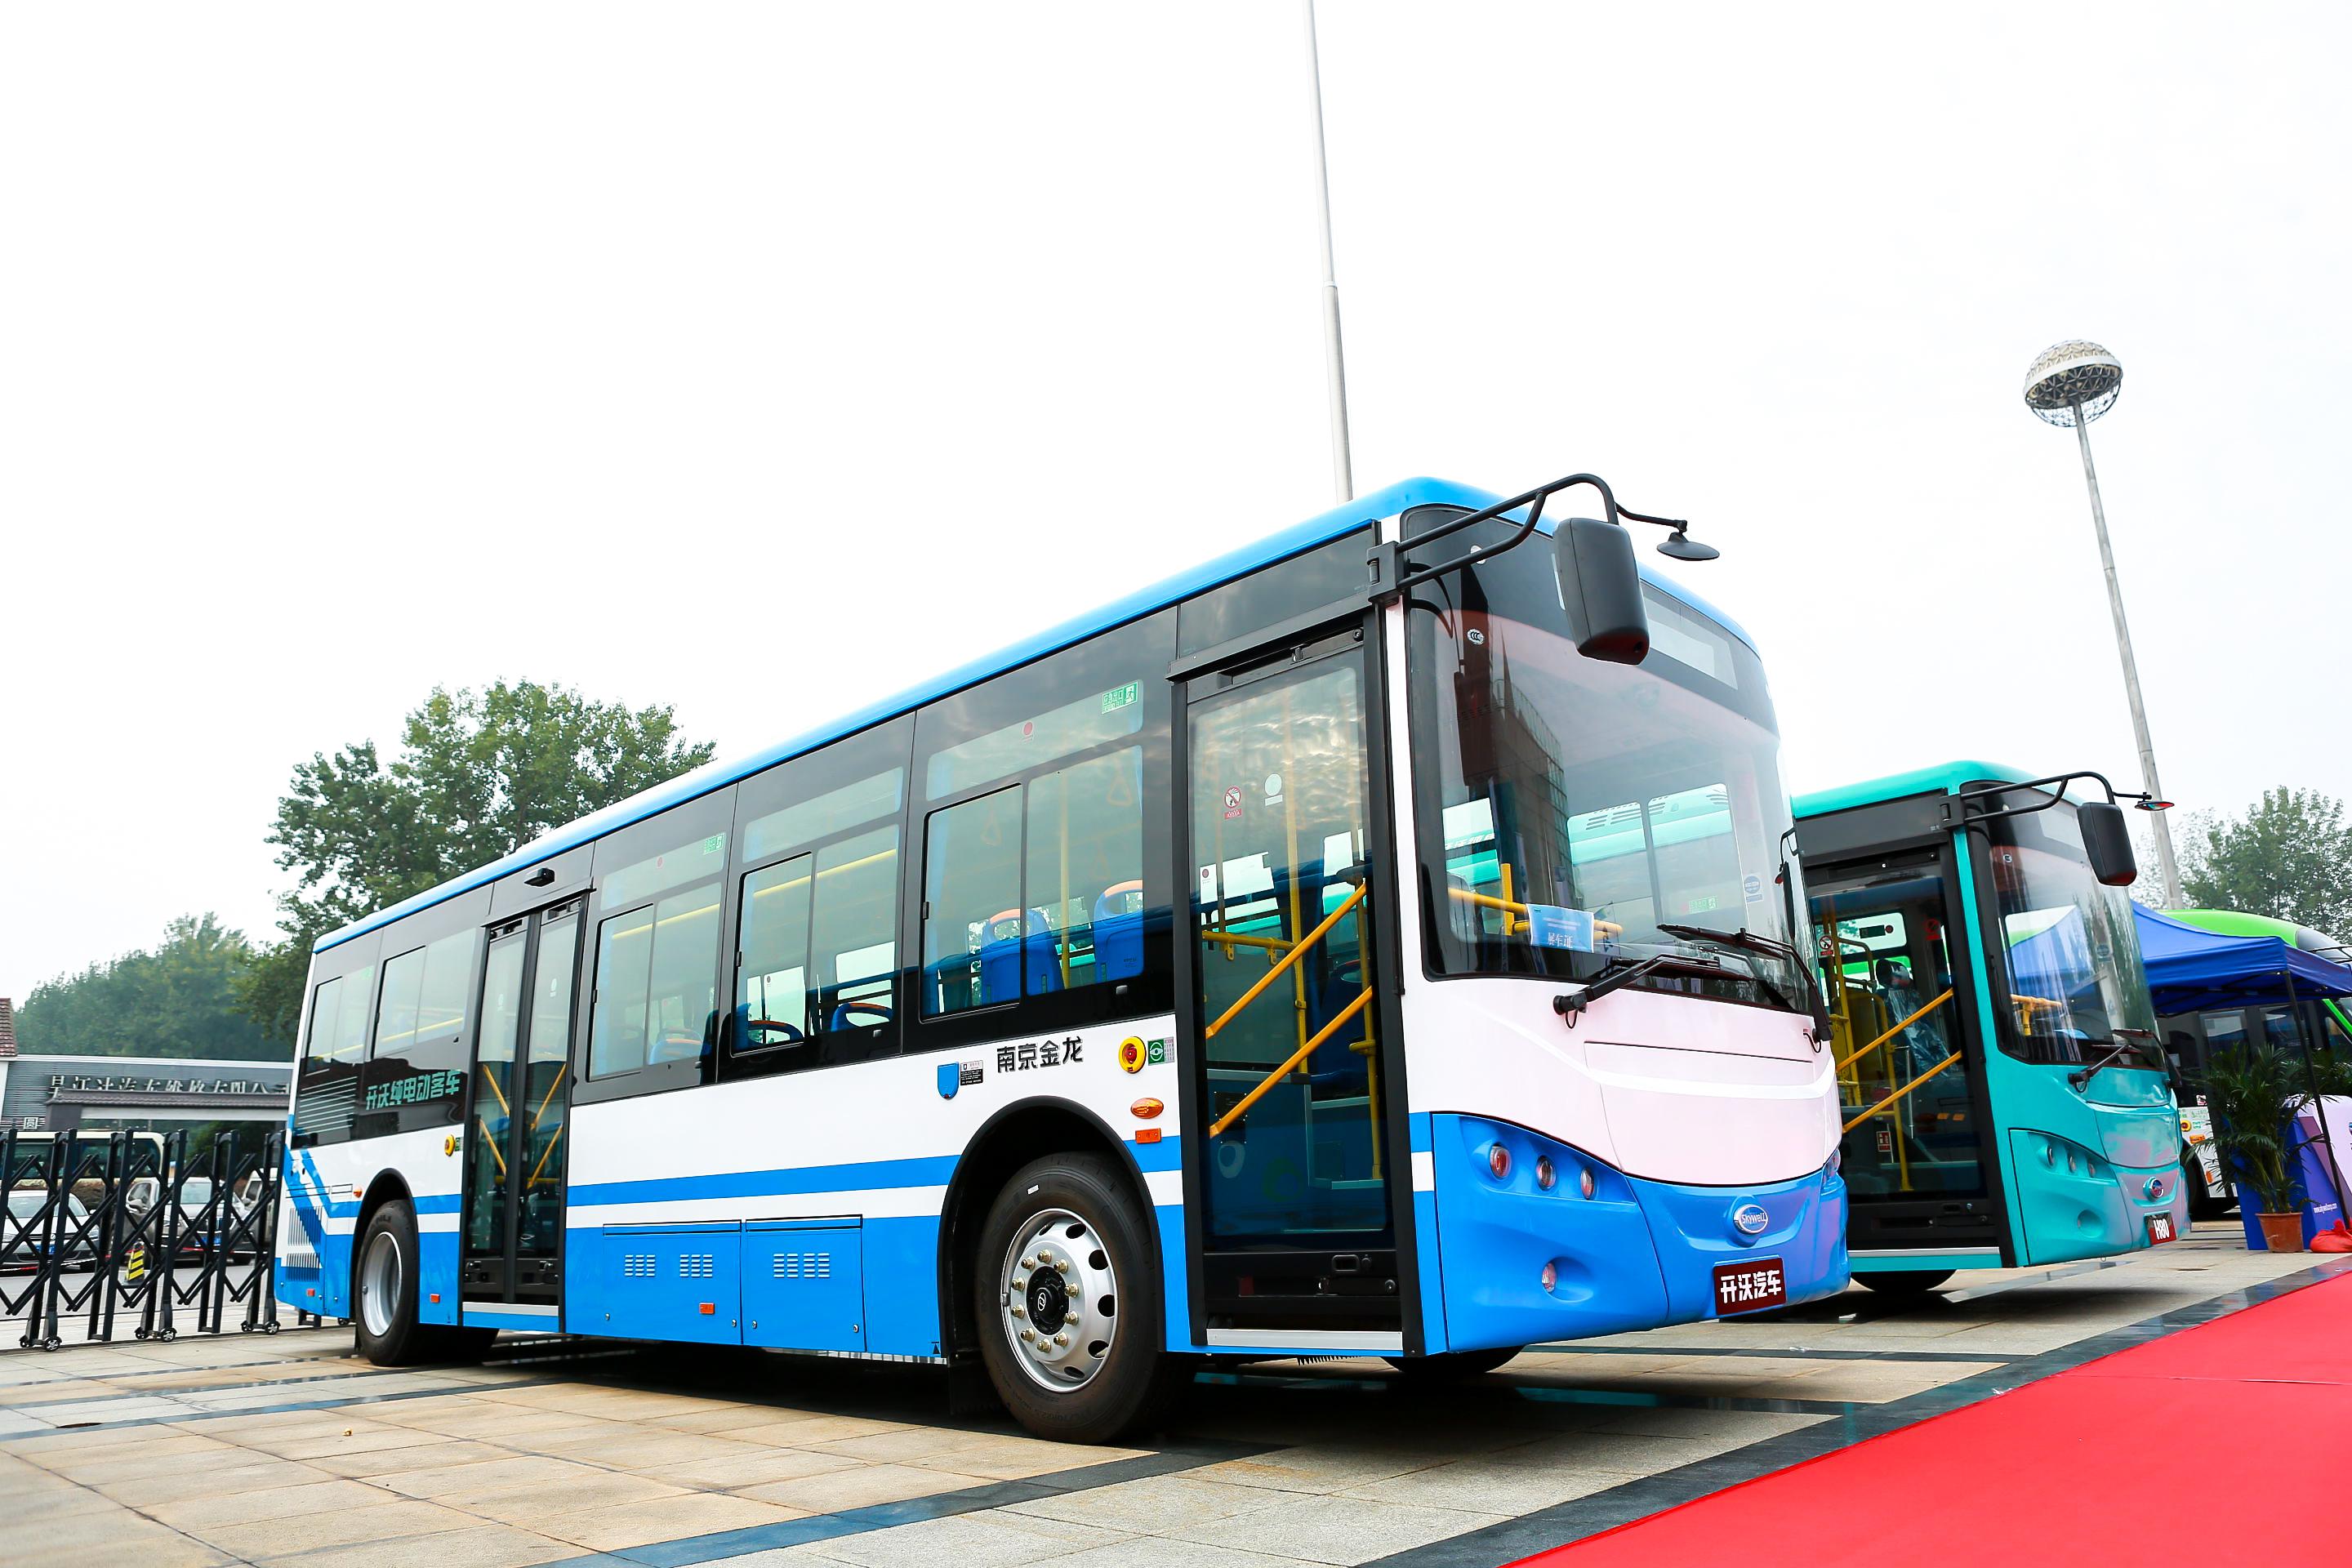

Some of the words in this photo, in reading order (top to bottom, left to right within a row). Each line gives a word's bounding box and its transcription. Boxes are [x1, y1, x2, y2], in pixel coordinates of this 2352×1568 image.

[996, 1036, 1084, 1073] 南京金龙
[366, 1069, 460, 1111] 开沃纯电动客车
[2153, 1218, 2170, 1240] H80
[1720, 1270, 1782, 1304] 开沃汽车
